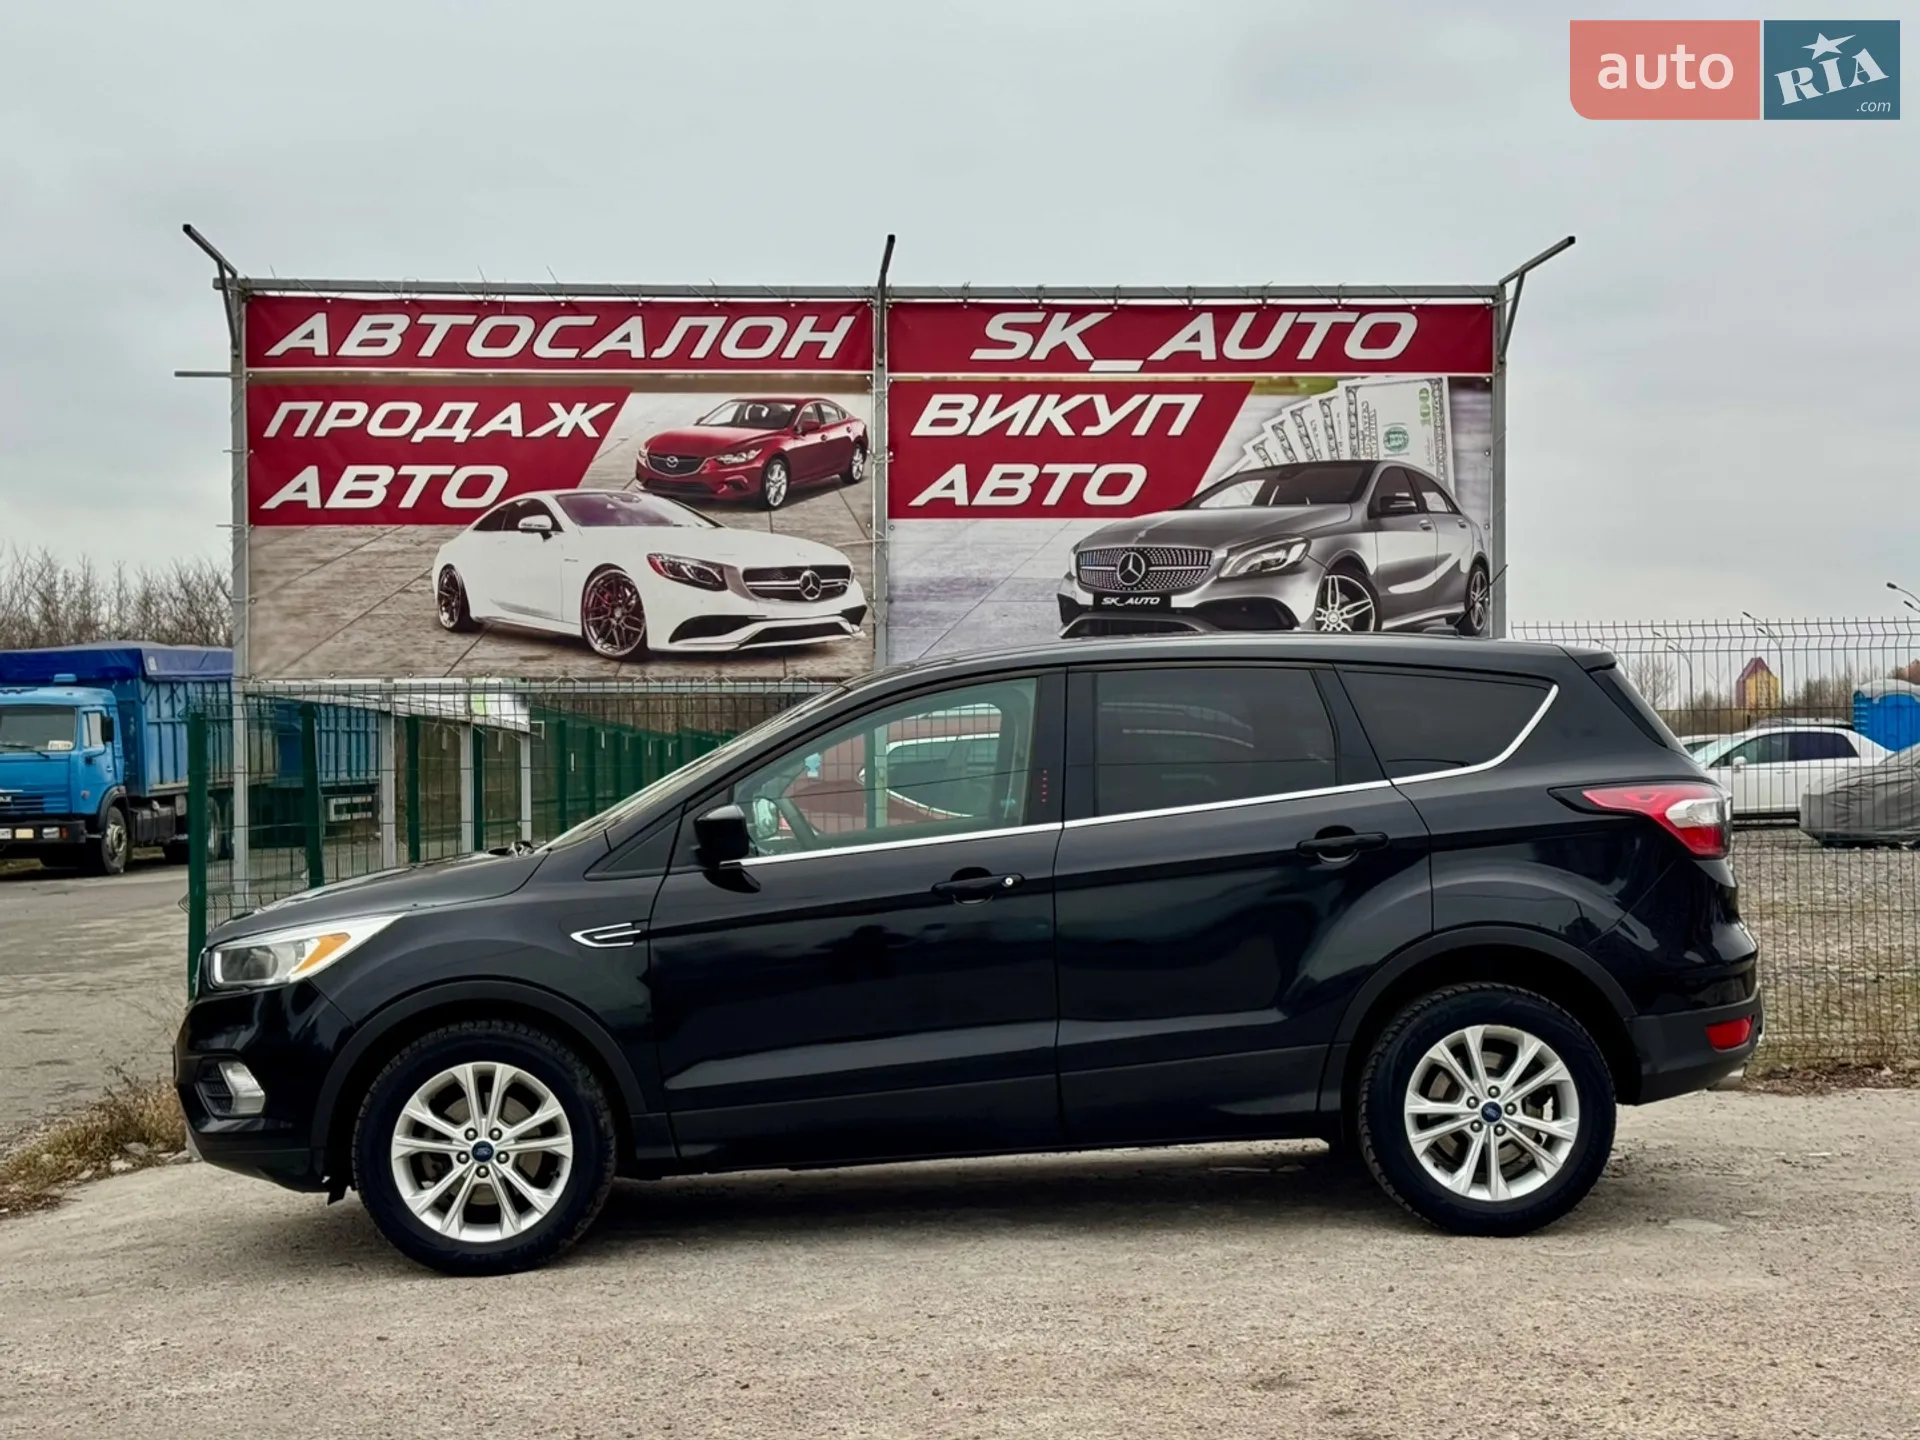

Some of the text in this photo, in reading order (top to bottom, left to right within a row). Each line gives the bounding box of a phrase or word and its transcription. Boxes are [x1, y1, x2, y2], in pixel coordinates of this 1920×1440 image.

[264, 312, 856, 359] АВТОСАЛОН
[969, 311, 1418, 372] SK_AUTO
[263, 401, 616, 443] ПРОДАЖ
[910, 393, 1203, 436] ВИКУП
[260, 465, 509, 509] АВТО
[908, 463, 1148, 506] АВТО
[1101, 596, 1161, 607] SK_AUTO
